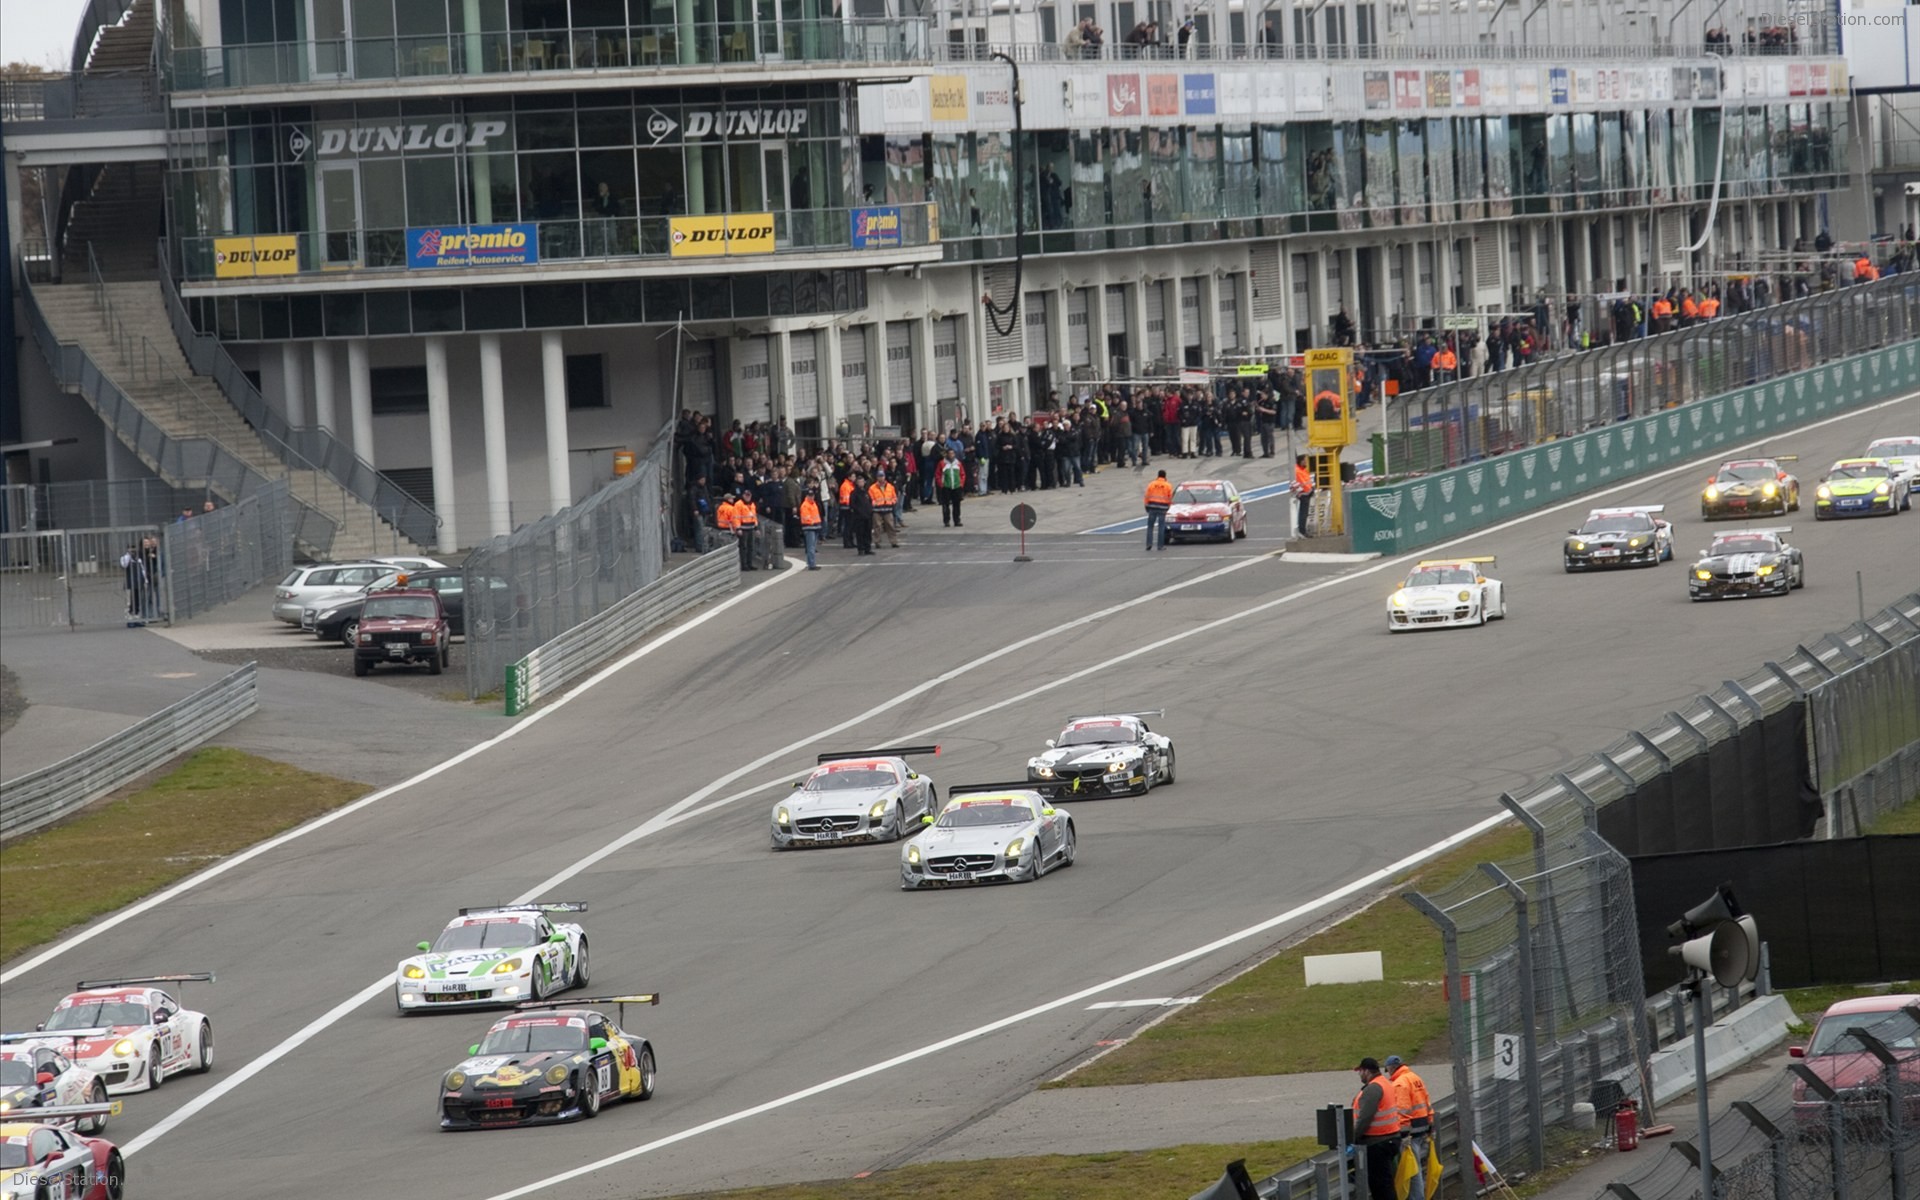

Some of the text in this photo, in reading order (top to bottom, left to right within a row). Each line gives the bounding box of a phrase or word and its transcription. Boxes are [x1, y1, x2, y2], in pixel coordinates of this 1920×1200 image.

[684, 107, 808, 138] DUNLOP
[318, 121, 507, 156] DUNLOP
[689, 226, 773, 243] DUNLOP
[866, 210, 898, 236] premio
[438, 228, 526, 255] premio
[228, 248, 296, 264] DUNLOP
[1311, 351, 1339, 362] ADAC
[442, 983, 458, 992] H&R
[1501, 1037, 1514, 1066] 3
